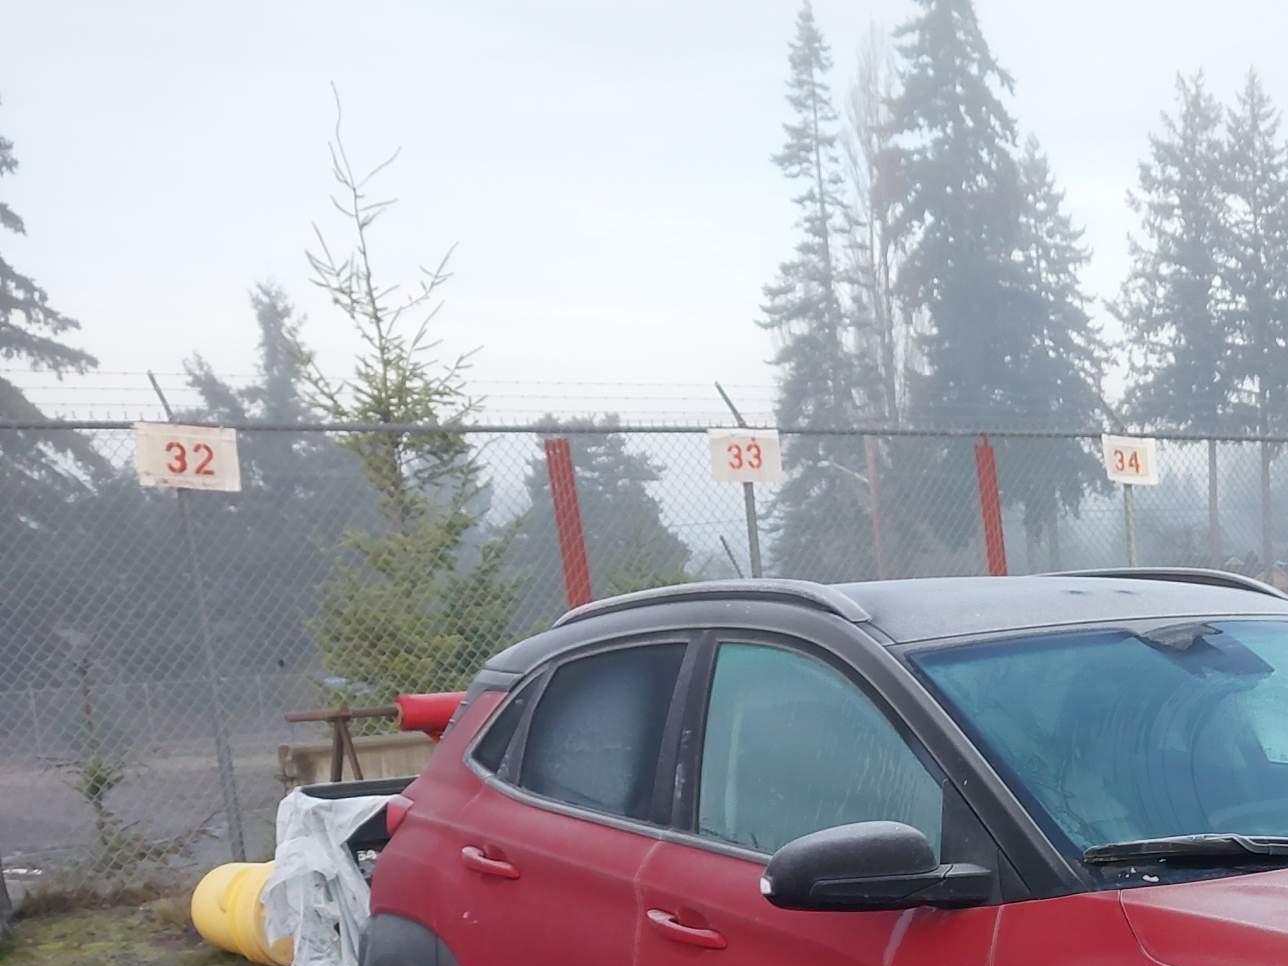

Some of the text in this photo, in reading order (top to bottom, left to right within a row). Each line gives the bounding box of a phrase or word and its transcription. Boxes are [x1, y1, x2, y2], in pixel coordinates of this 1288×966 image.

[165, 441, 215, 476] 32
[728, 443, 762, 470] 33
[1113, 448, 1140, 474] 34
